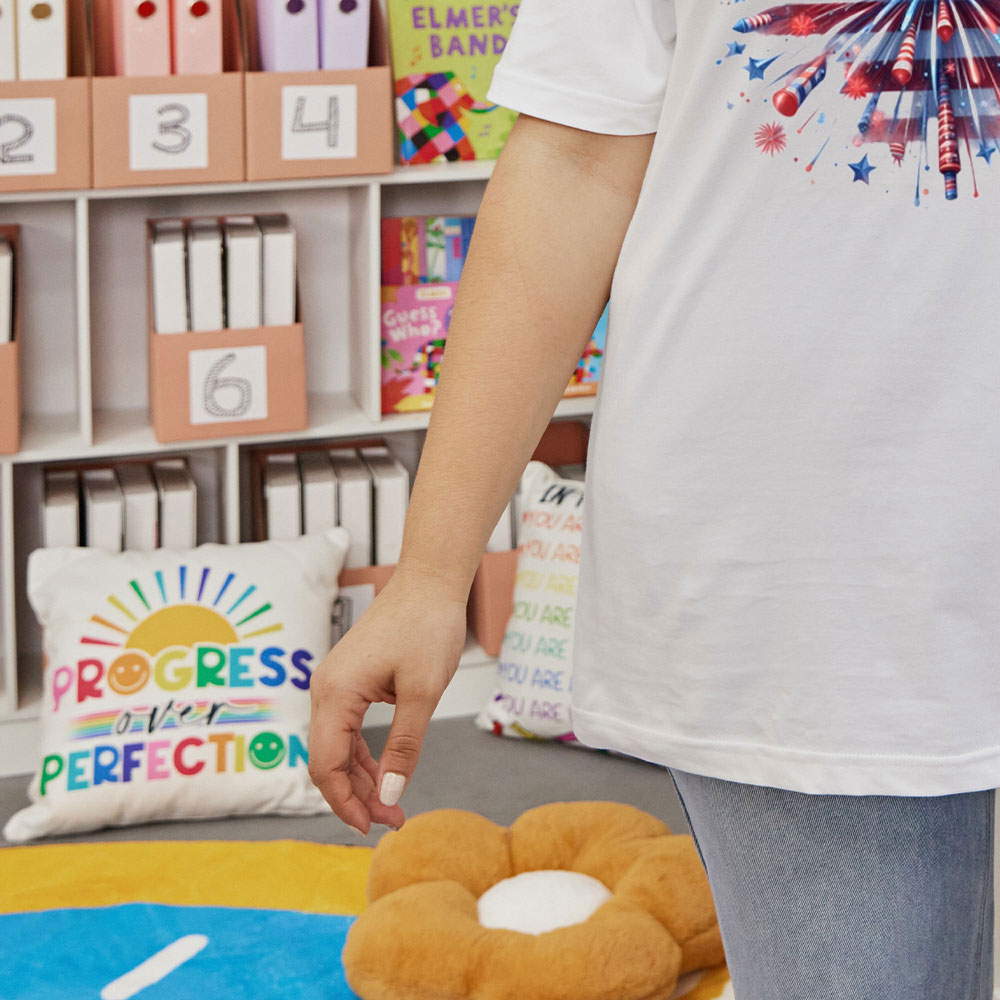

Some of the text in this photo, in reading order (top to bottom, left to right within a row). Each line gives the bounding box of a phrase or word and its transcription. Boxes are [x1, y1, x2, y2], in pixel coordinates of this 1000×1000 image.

[429, 34, 508, 60] BAND
[152, 102, 192, 155] 3
[290, 95, 340, 148] 4
[0, 113, 34, 164] 2
[383, 305, 438, 328] Guess
[388, 318, 443, 343] Who?
[204, 352, 253, 418] 6
[540, 603, 573, 629] ARE
[535, 635, 567, 661] ARE
[532, 668, 565, 692] ARE
[116, 698, 258, 734] over
[530, 699, 564, 721] ARE
